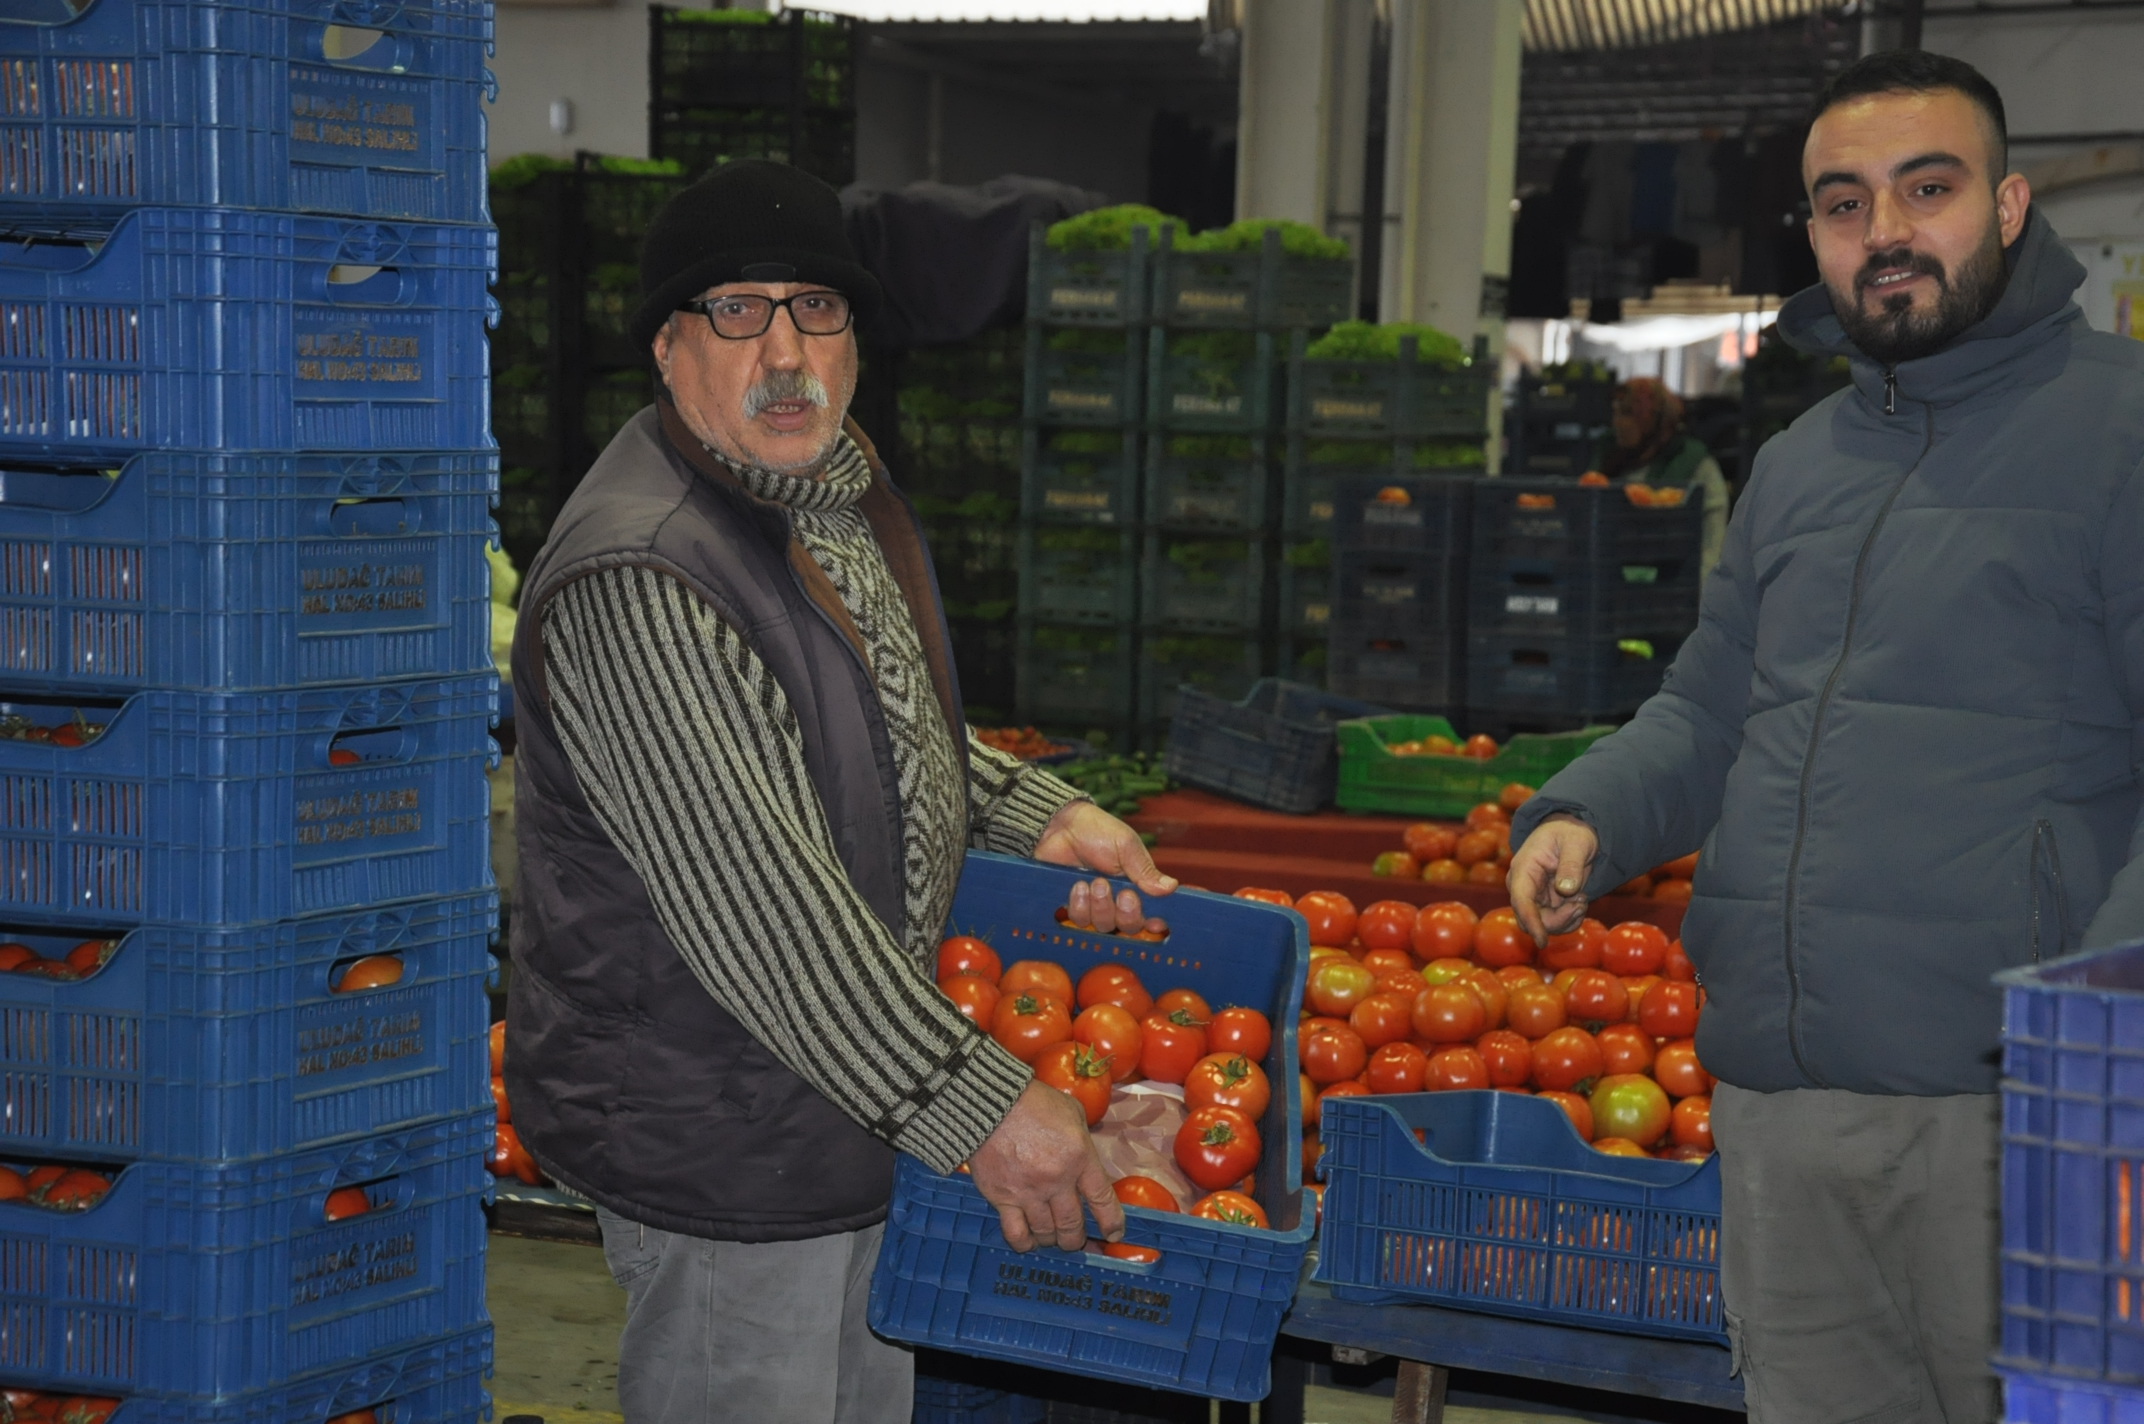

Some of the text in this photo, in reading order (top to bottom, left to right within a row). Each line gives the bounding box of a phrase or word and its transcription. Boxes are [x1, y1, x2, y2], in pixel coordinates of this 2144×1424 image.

[993, 1279, 1031, 1299] HAL
[1037, 1286, 1093, 1310] NO:43
[998, 1262, 1172, 1309] ULUDAĞ TARIM
